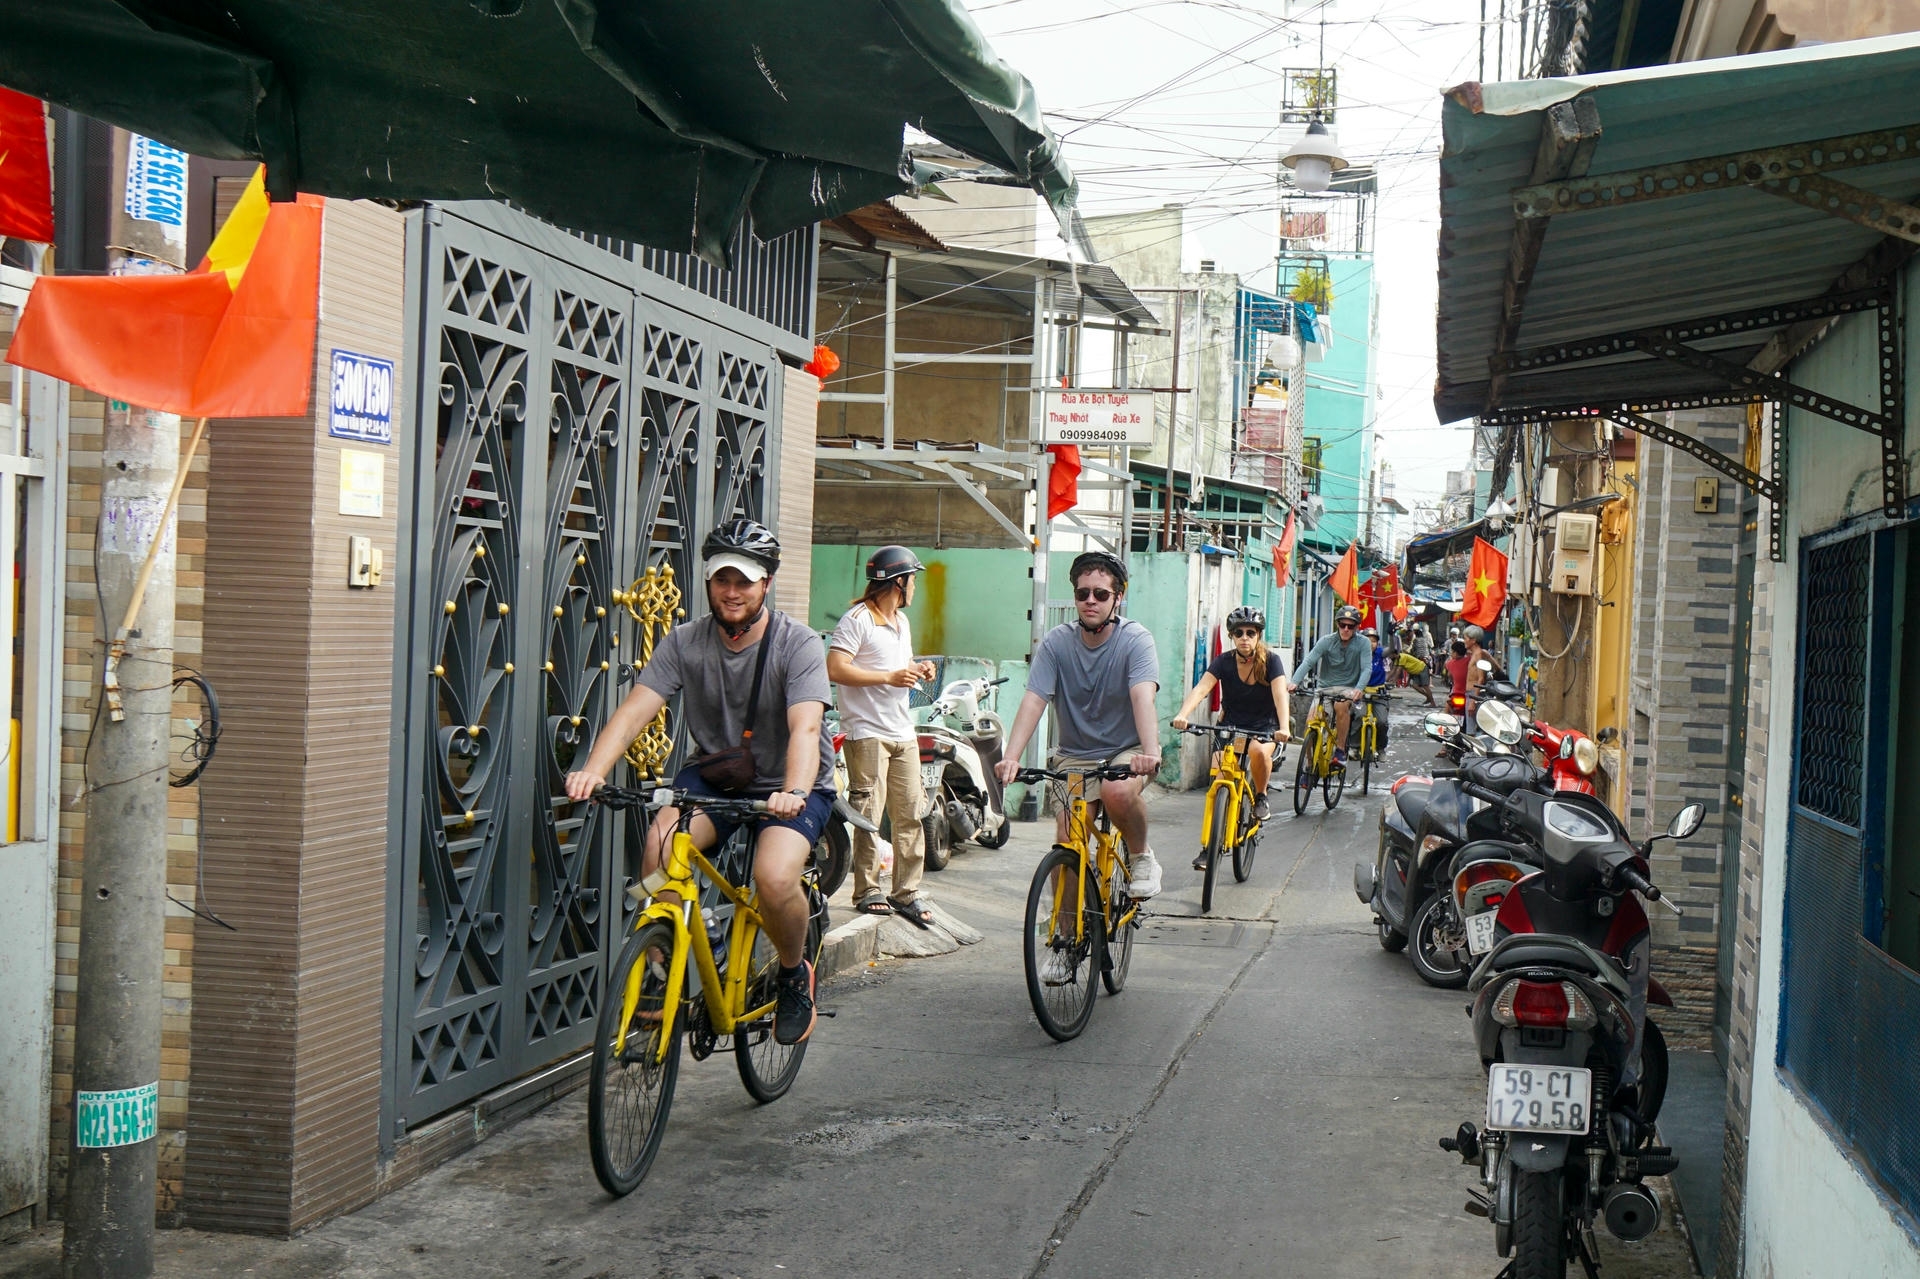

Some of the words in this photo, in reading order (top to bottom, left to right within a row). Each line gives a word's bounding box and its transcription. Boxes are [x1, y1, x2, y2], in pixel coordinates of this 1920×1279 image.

[147, 161, 183, 190] 556
[146, 189, 182, 226] 0923
[335, 360, 389, 416] 500/130
[1079, 394, 1089, 404] Xe
[1049, 412, 1068, 424] Thay
[1129, 413, 1141, 423] Xe
[1060, 430, 1127, 440] 0909984098
[1475, 916, 1491, 933] 53
[1505, 1069, 1572, 1098] 59-C1
[1494, 1098, 1583, 1130] 129.58
